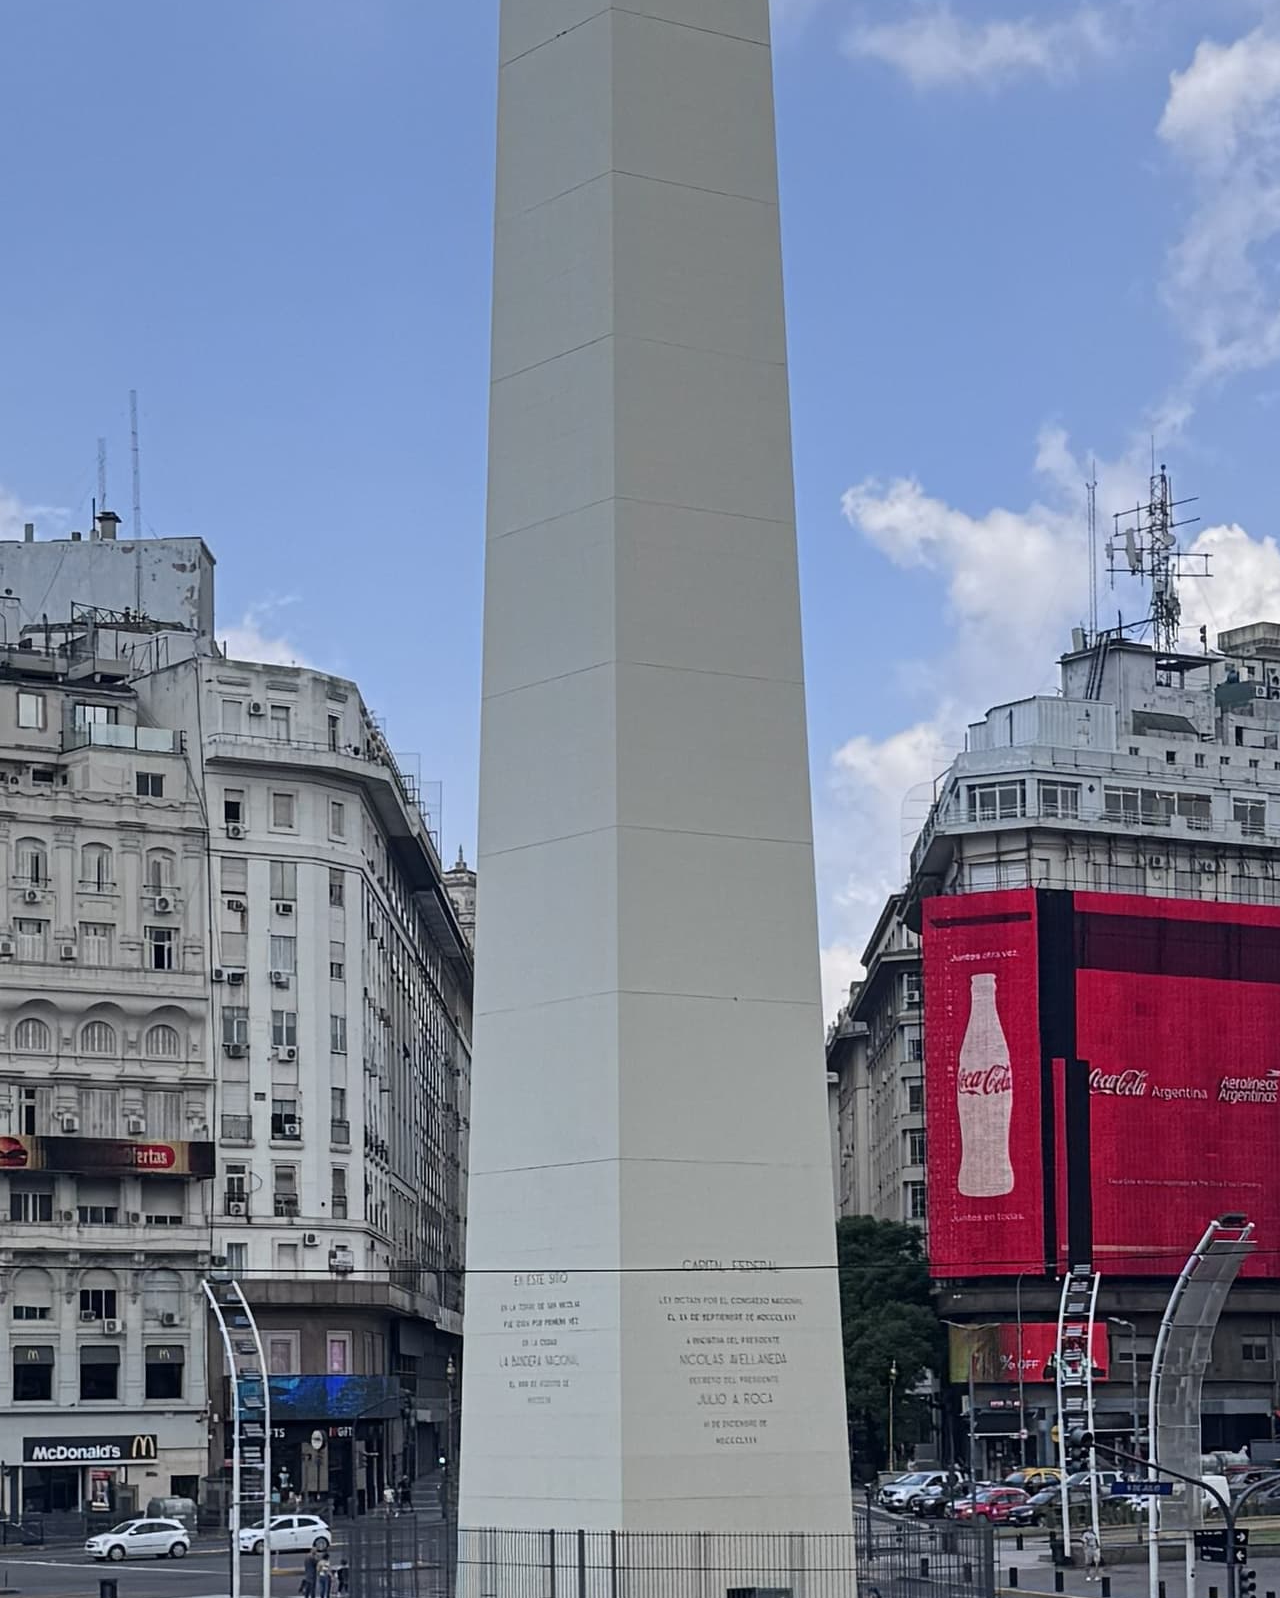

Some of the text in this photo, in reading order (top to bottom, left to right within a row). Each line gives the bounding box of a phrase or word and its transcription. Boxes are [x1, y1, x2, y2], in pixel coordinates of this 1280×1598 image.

[958, 1065, 1012, 1095] Coca-Cola
[1089, 1068, 1208, 1101] Coca-Cola Argentina
[1218, 1090, 1277, 1105] Argentinas
[32, 1442, 121, 1462] McDonald's
